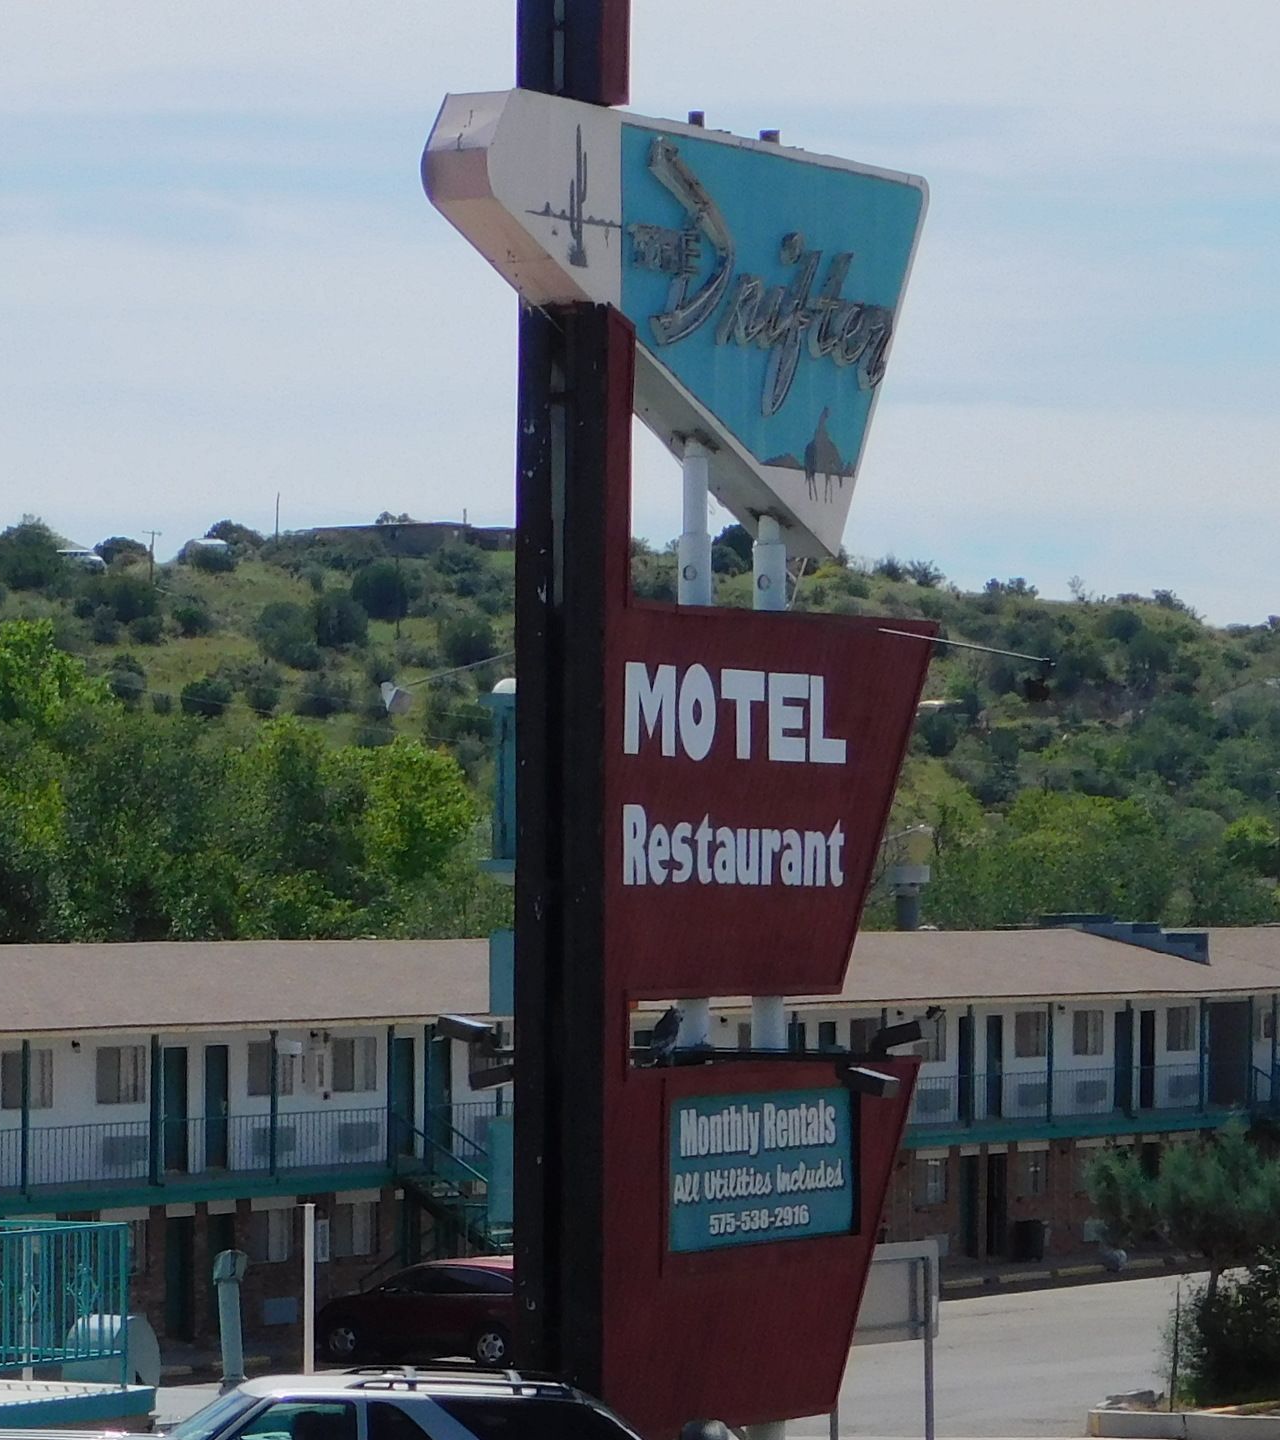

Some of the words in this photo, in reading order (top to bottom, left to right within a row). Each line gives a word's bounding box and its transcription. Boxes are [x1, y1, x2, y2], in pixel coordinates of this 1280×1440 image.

[623, 661, 847, 764] MOTEL
[623, 803, 845, 887] Restaurant
[680, 1104, 760, 1157] Monthly
[763, 1098, 836, 1149] Rentals
[673, 1171, 700, 1205] All
[704, 1166, 772, 1201] Utilities
[776, 1157, 844, 1194] Included
[709, 1204, 810, 1236] 575-538-2916
